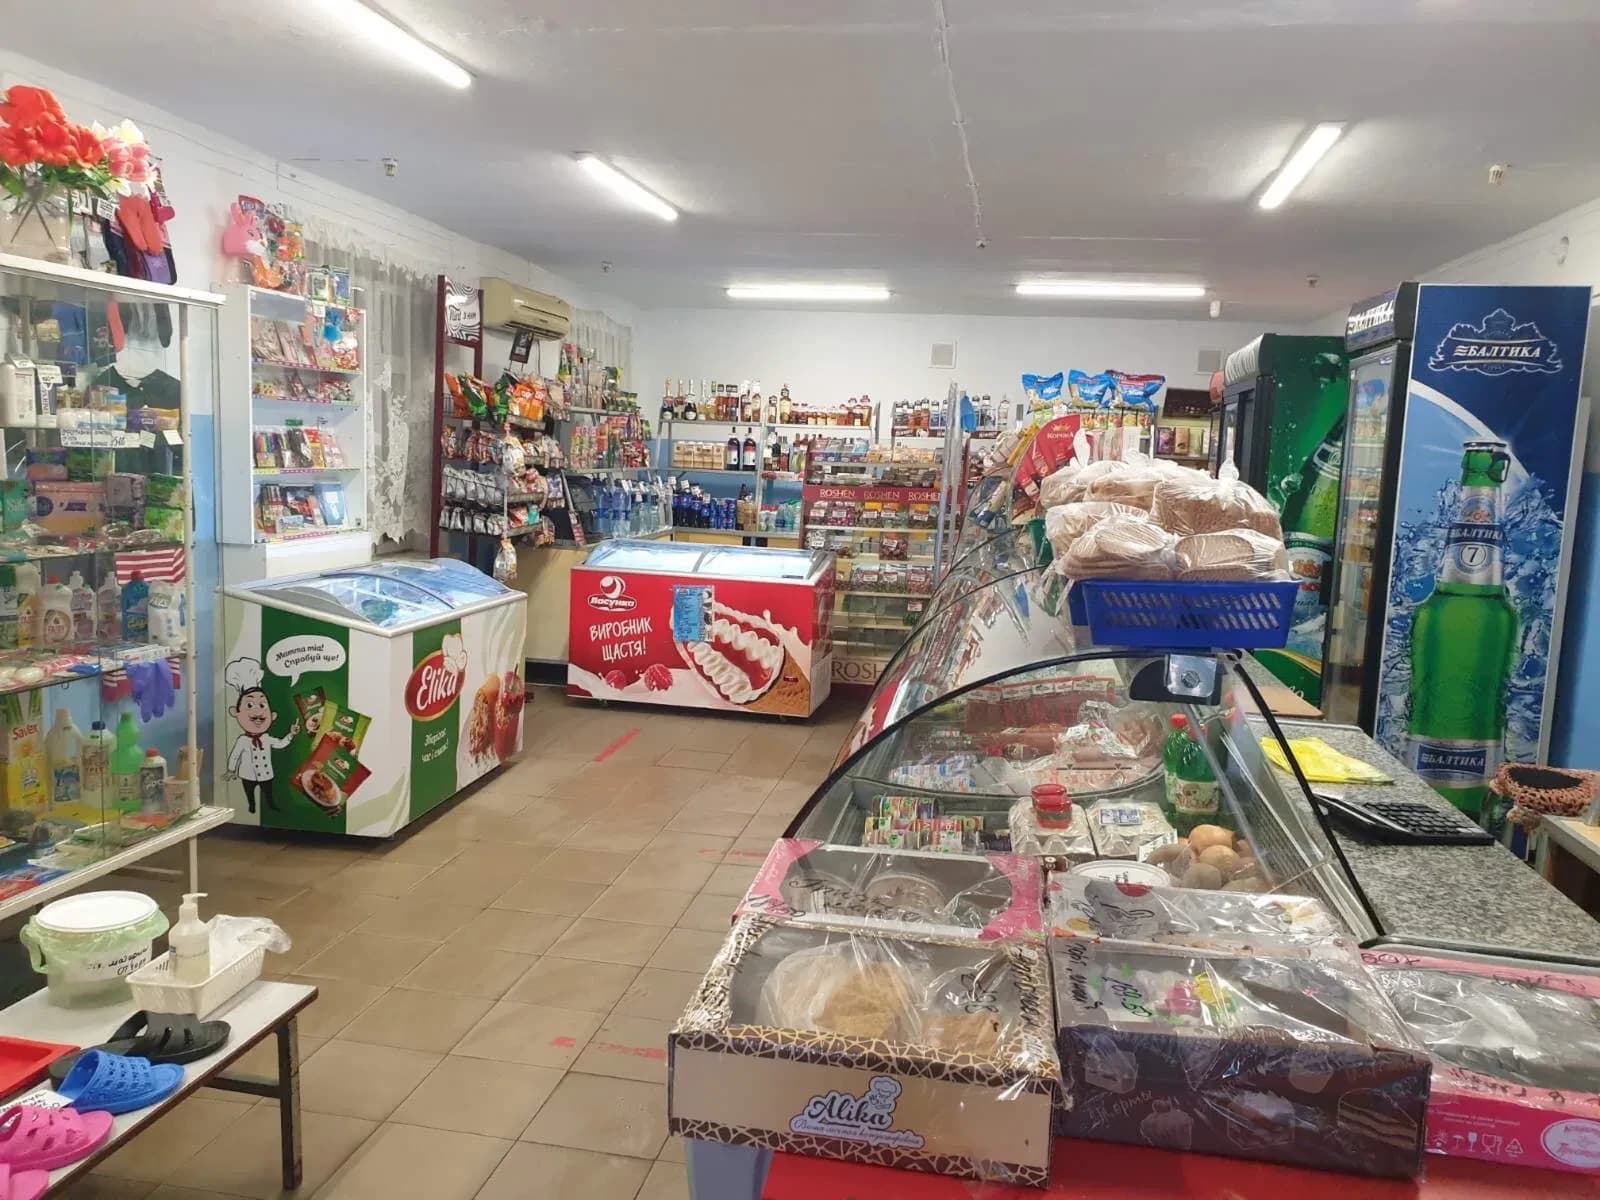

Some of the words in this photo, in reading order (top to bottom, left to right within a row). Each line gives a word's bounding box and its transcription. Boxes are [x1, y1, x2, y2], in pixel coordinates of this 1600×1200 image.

[1467, 345, 1541, 359] БАЛТИКА
[819, 488, 856, 500] ROSHEN
[863, 490, 901, 501] ROSHEN
[908, 491, 940, 502] ROSHE
[1467, 546, 1480, 564] 7
[589, 616, 653, 642] ВИРОБНИК
[602, 636, 647, 664] ЩАСТЯ!
[284, 652, 321, 668] Спробуй
[323, 654, 340, 662] ще!
[831, 660, 884, 682] ROSH
[416, 664, 458, 711] Elika
[1429, 754, 1485, 767] БАЛТИКА
[808, 1095, 889, 1125] Alika
